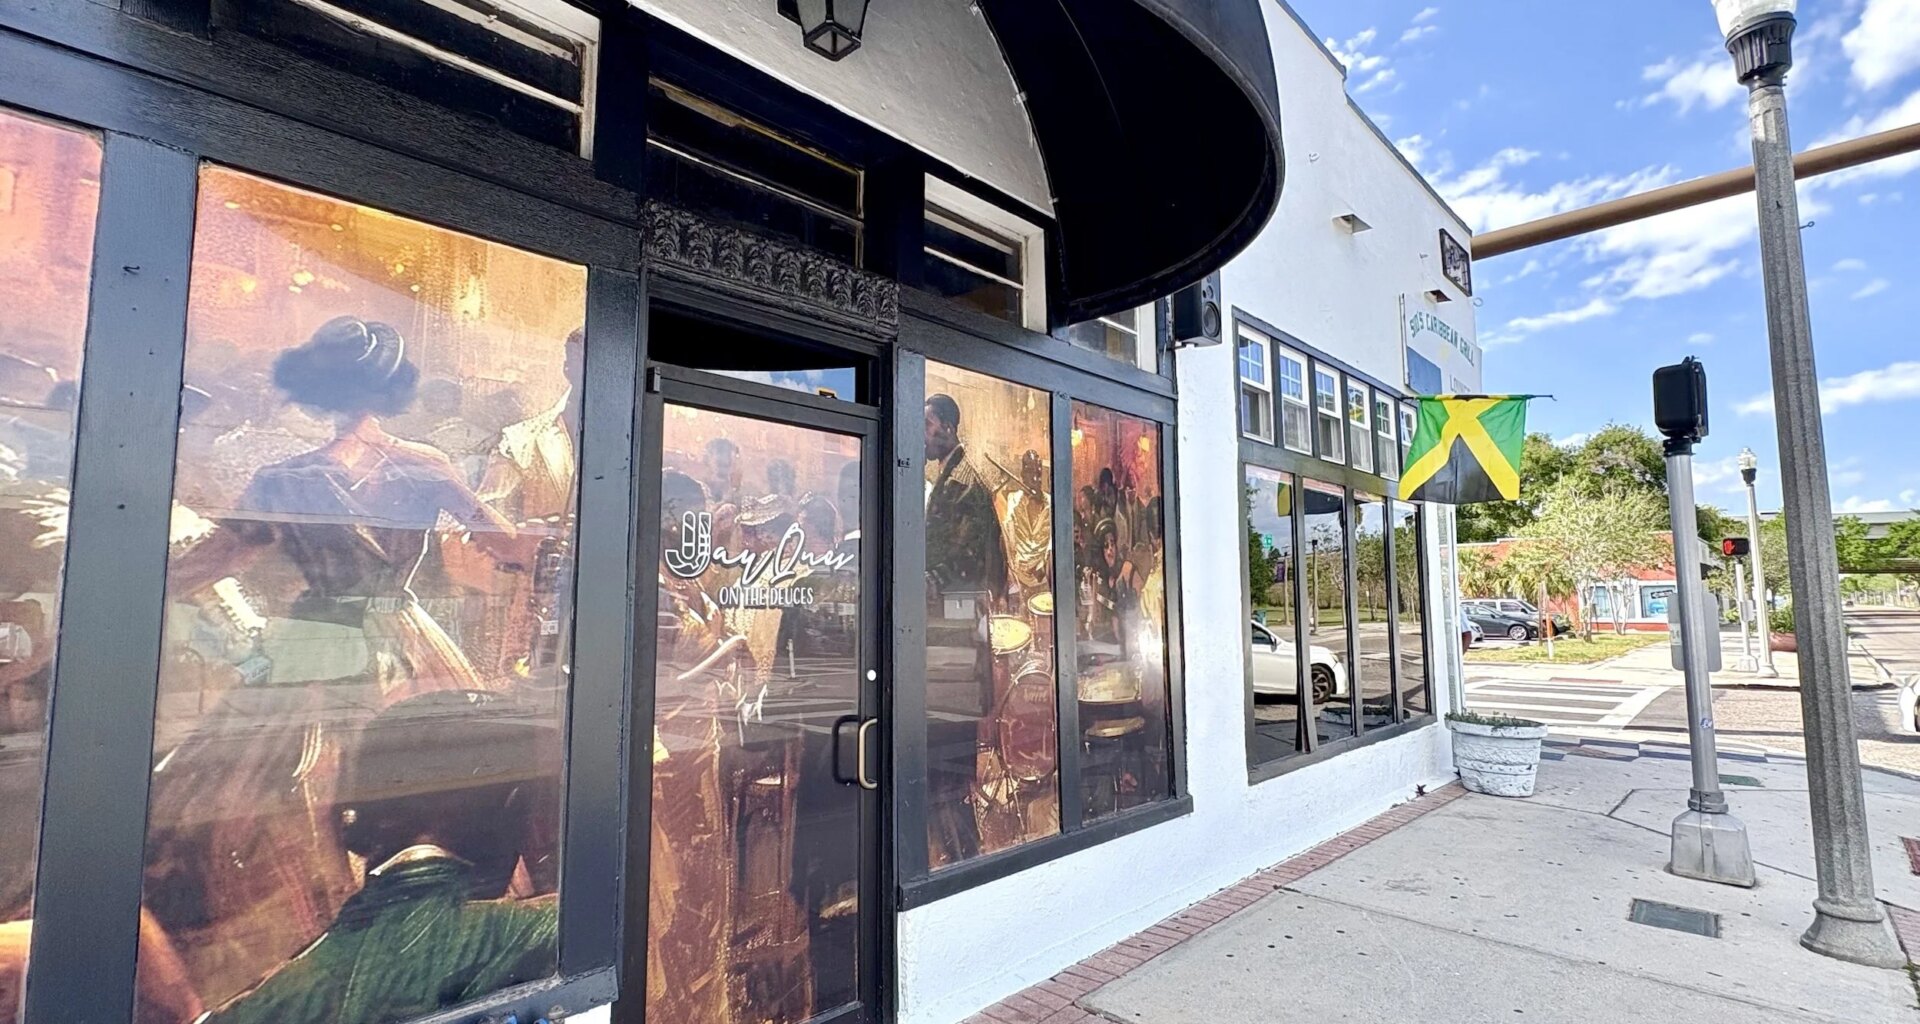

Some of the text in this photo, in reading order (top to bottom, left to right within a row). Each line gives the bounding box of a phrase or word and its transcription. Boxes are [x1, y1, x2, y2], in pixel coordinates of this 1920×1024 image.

[1426, 313, 1458, 349] CARIBBEAN
[665, 511, 774, 585] Jay
[719, 586, 814, 606] ON THE DEUCES
